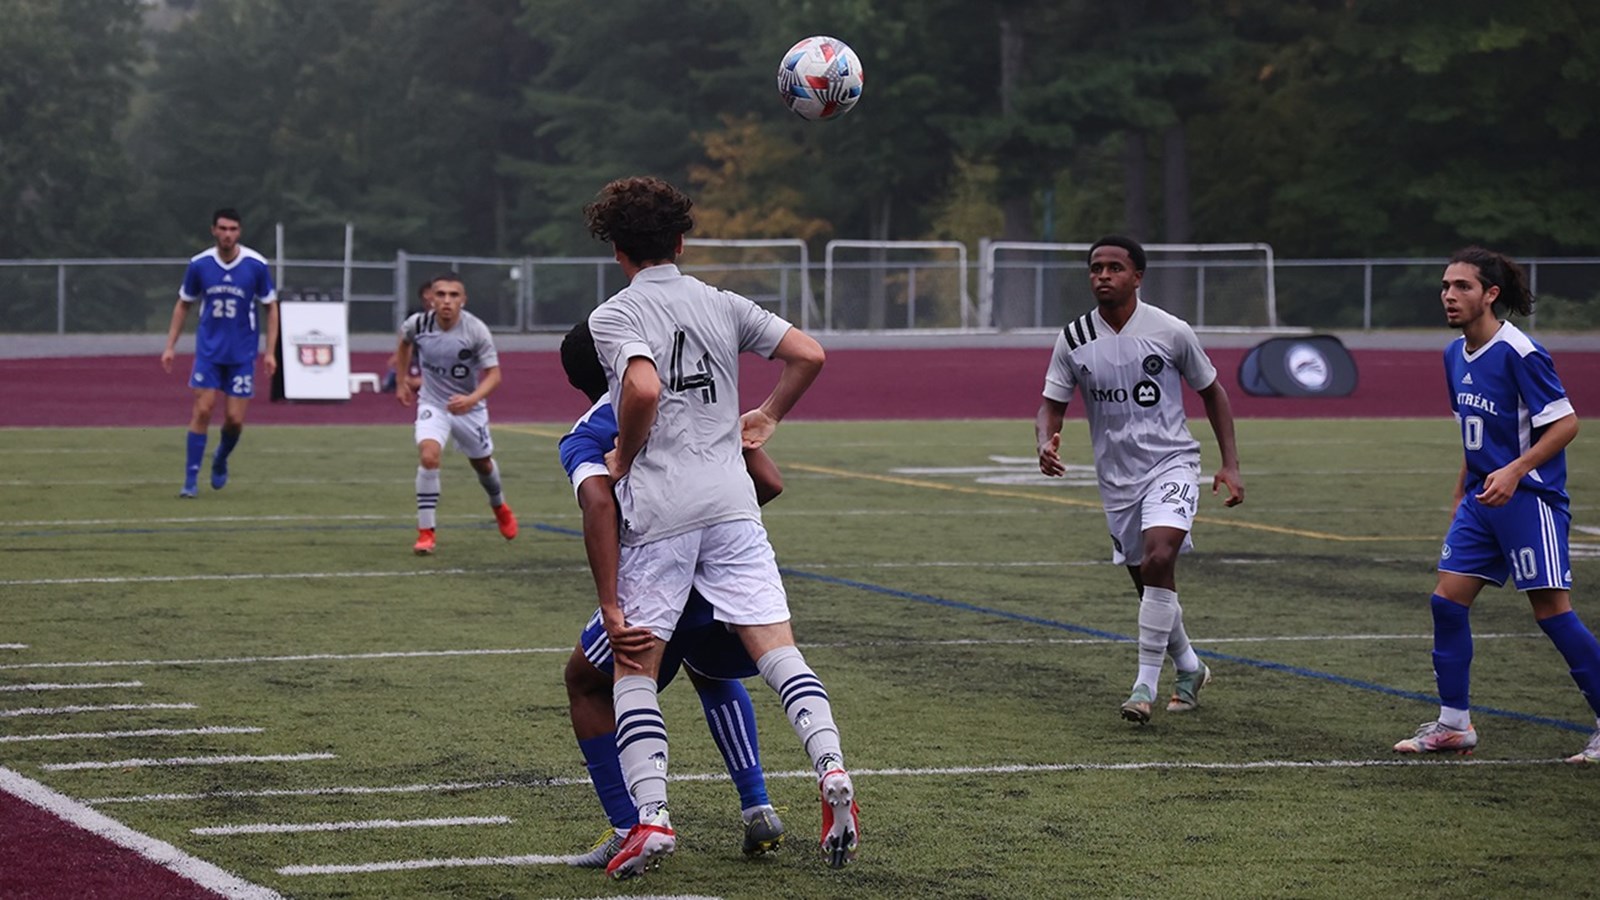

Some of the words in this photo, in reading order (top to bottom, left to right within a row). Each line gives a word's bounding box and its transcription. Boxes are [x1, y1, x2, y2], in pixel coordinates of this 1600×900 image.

[212, 299, 237, 318] 25
[669, 330, 718, 405] 4
[232, 375, 252, 394] 25
[1160, 481, 1196, 513] 24
[1509, 547, 1537, 580] 10
